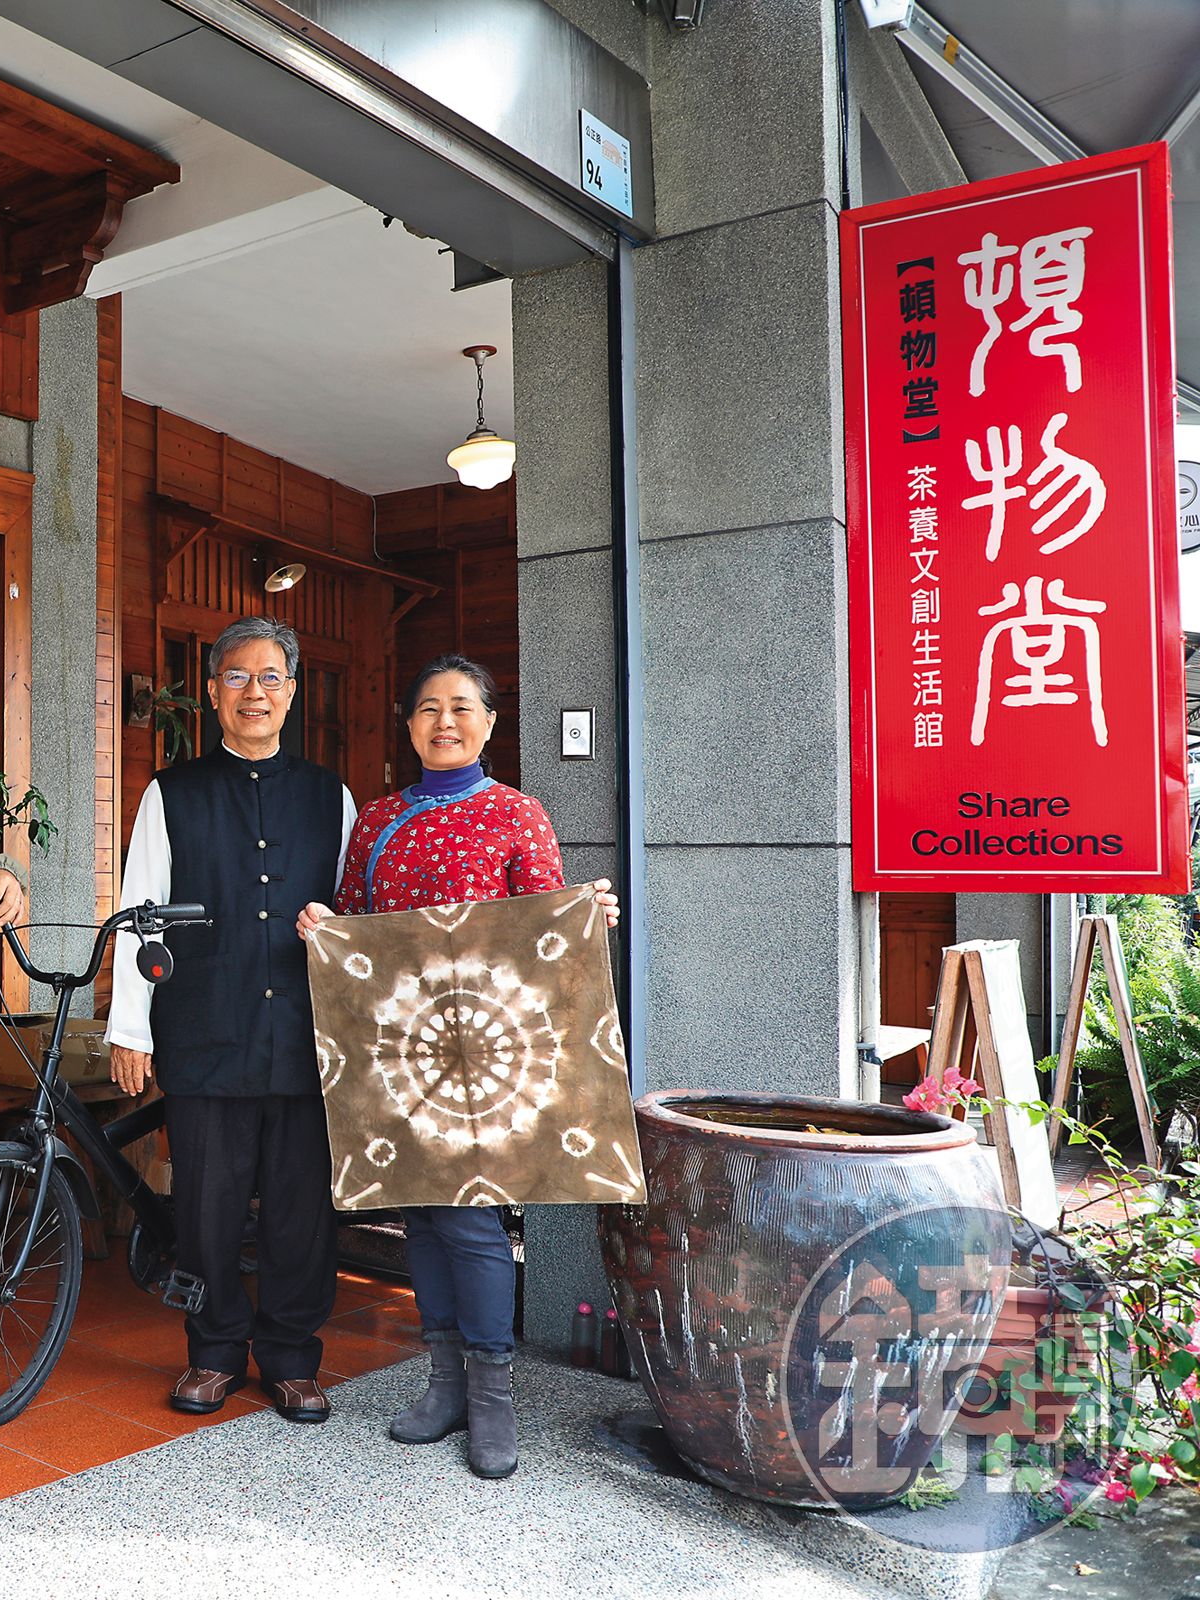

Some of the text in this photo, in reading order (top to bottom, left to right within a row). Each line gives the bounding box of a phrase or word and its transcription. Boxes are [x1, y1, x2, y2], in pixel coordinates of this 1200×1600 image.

[586, 158, 603, 191] 94
[896, 256, 944, 748] 【頓物堂】 茶養文創生活館
[956, 226, 1109, 747] 頓物堂
[957, 791, 1071, 819] Share
[910, 828, 1124, 857] Collections
